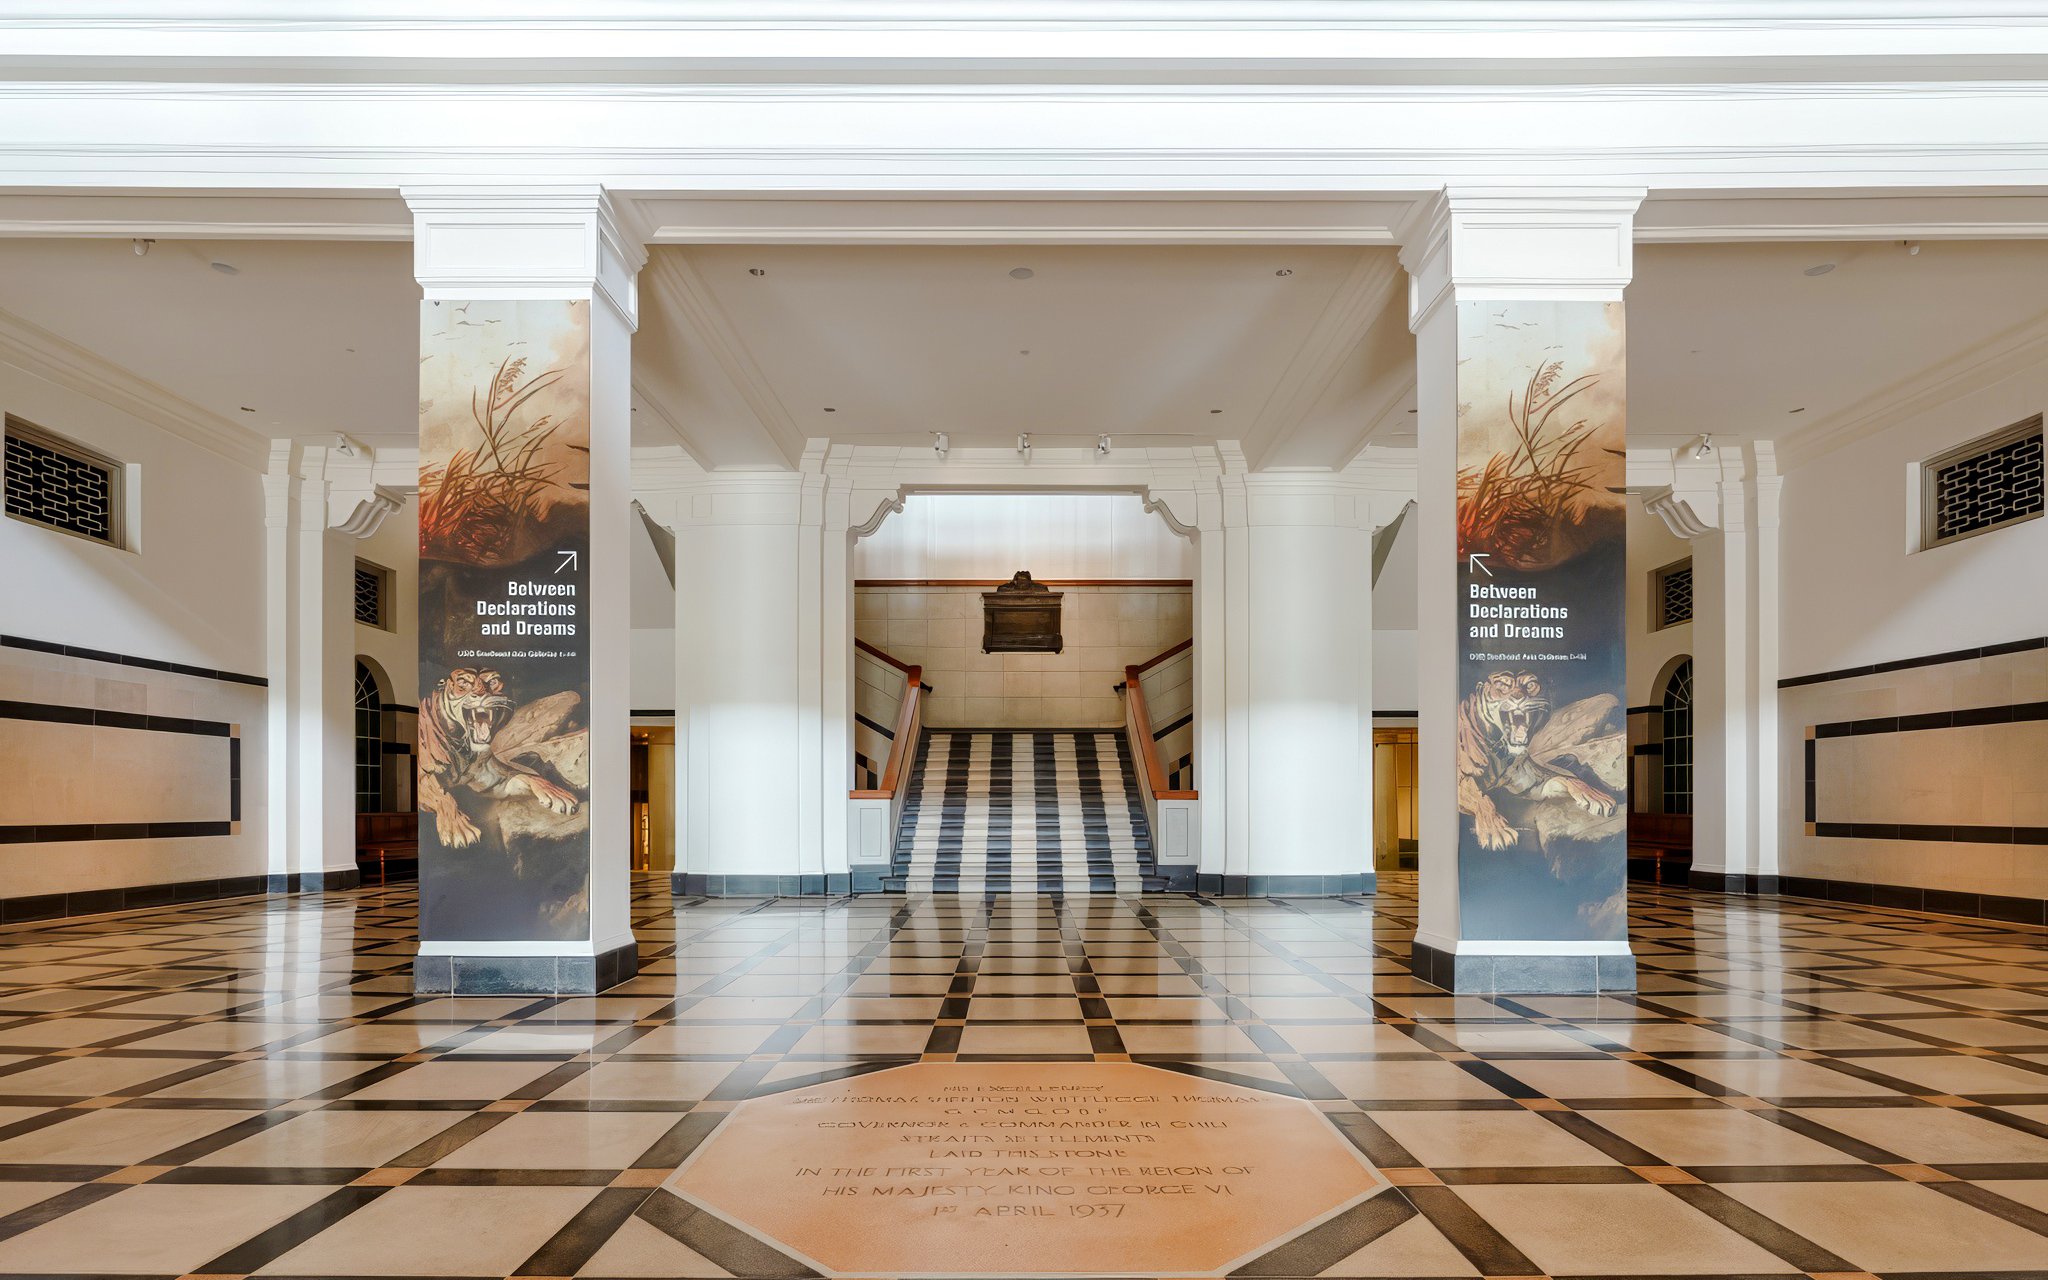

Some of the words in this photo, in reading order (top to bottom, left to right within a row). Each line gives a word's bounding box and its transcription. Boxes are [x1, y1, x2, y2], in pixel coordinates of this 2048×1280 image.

[477, 600, 576, 616] Declarations
[1470, 604, 1568, 619] Declarations
[481, 621, 511, 635] and
[516, 621, 576, 635] Dreams
[1469, 624, 1498, 638] and
[1504, 624, 1564, 638] Dreams
[981, 1120, 1133, 1129] COMMANDER
[929, 1149, 982, 1159] LAID
[992, 1149, 1038, 1158] THIS
[1046, 1149, 1128, 1158] STONE
[795, 1168, 822, 1177] IN
[831, 1167, 877, 1177] THE
[886, 1167, 953, 1177] FIRST
[964, 1167, 1031, 1177] YEAR
[1039, 1166, 1074, 1176] OF
[1088, 1166, 1131, 1176] THE
[1139, 1166, 1214, 1176] REIGN
[1223, 1166, 1256, 1175] OF
[822, 1186, 859, 1196] HIS
[872, 1185, 997, 1198] MAJESTY
[1009, 1185, 1075, 1196] KING
[1087, 1185, 1196, 1195] GEORGE
[1203, 1185, 1234, 1196] VI
[975, 1205, 1055, 1217] APRIL
[1069, 1203, 1126, 1218] 1937
